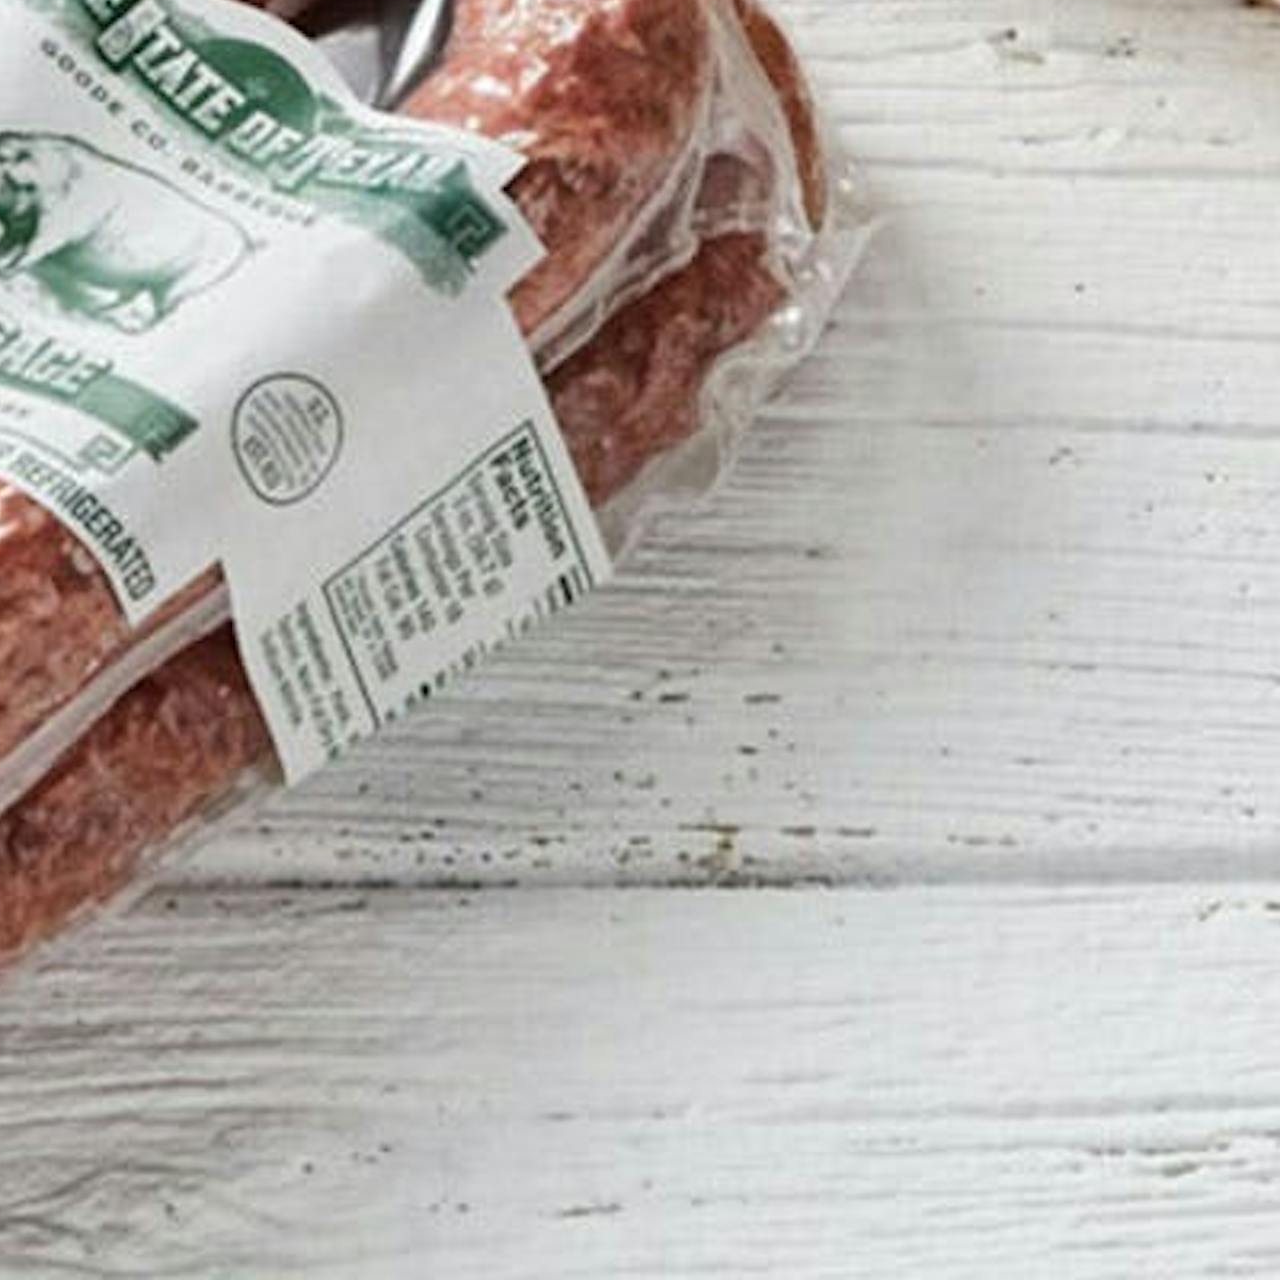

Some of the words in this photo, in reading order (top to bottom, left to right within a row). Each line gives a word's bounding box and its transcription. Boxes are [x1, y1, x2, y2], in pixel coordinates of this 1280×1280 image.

[39, 37, 123, 118] GOODE
[226, 110, 305, 170] OF
[7, 449, 157, 602] REFRIGERATED
[489, 450, 531, 531] Facts
[510, 436, 565, 560] Nutrition
